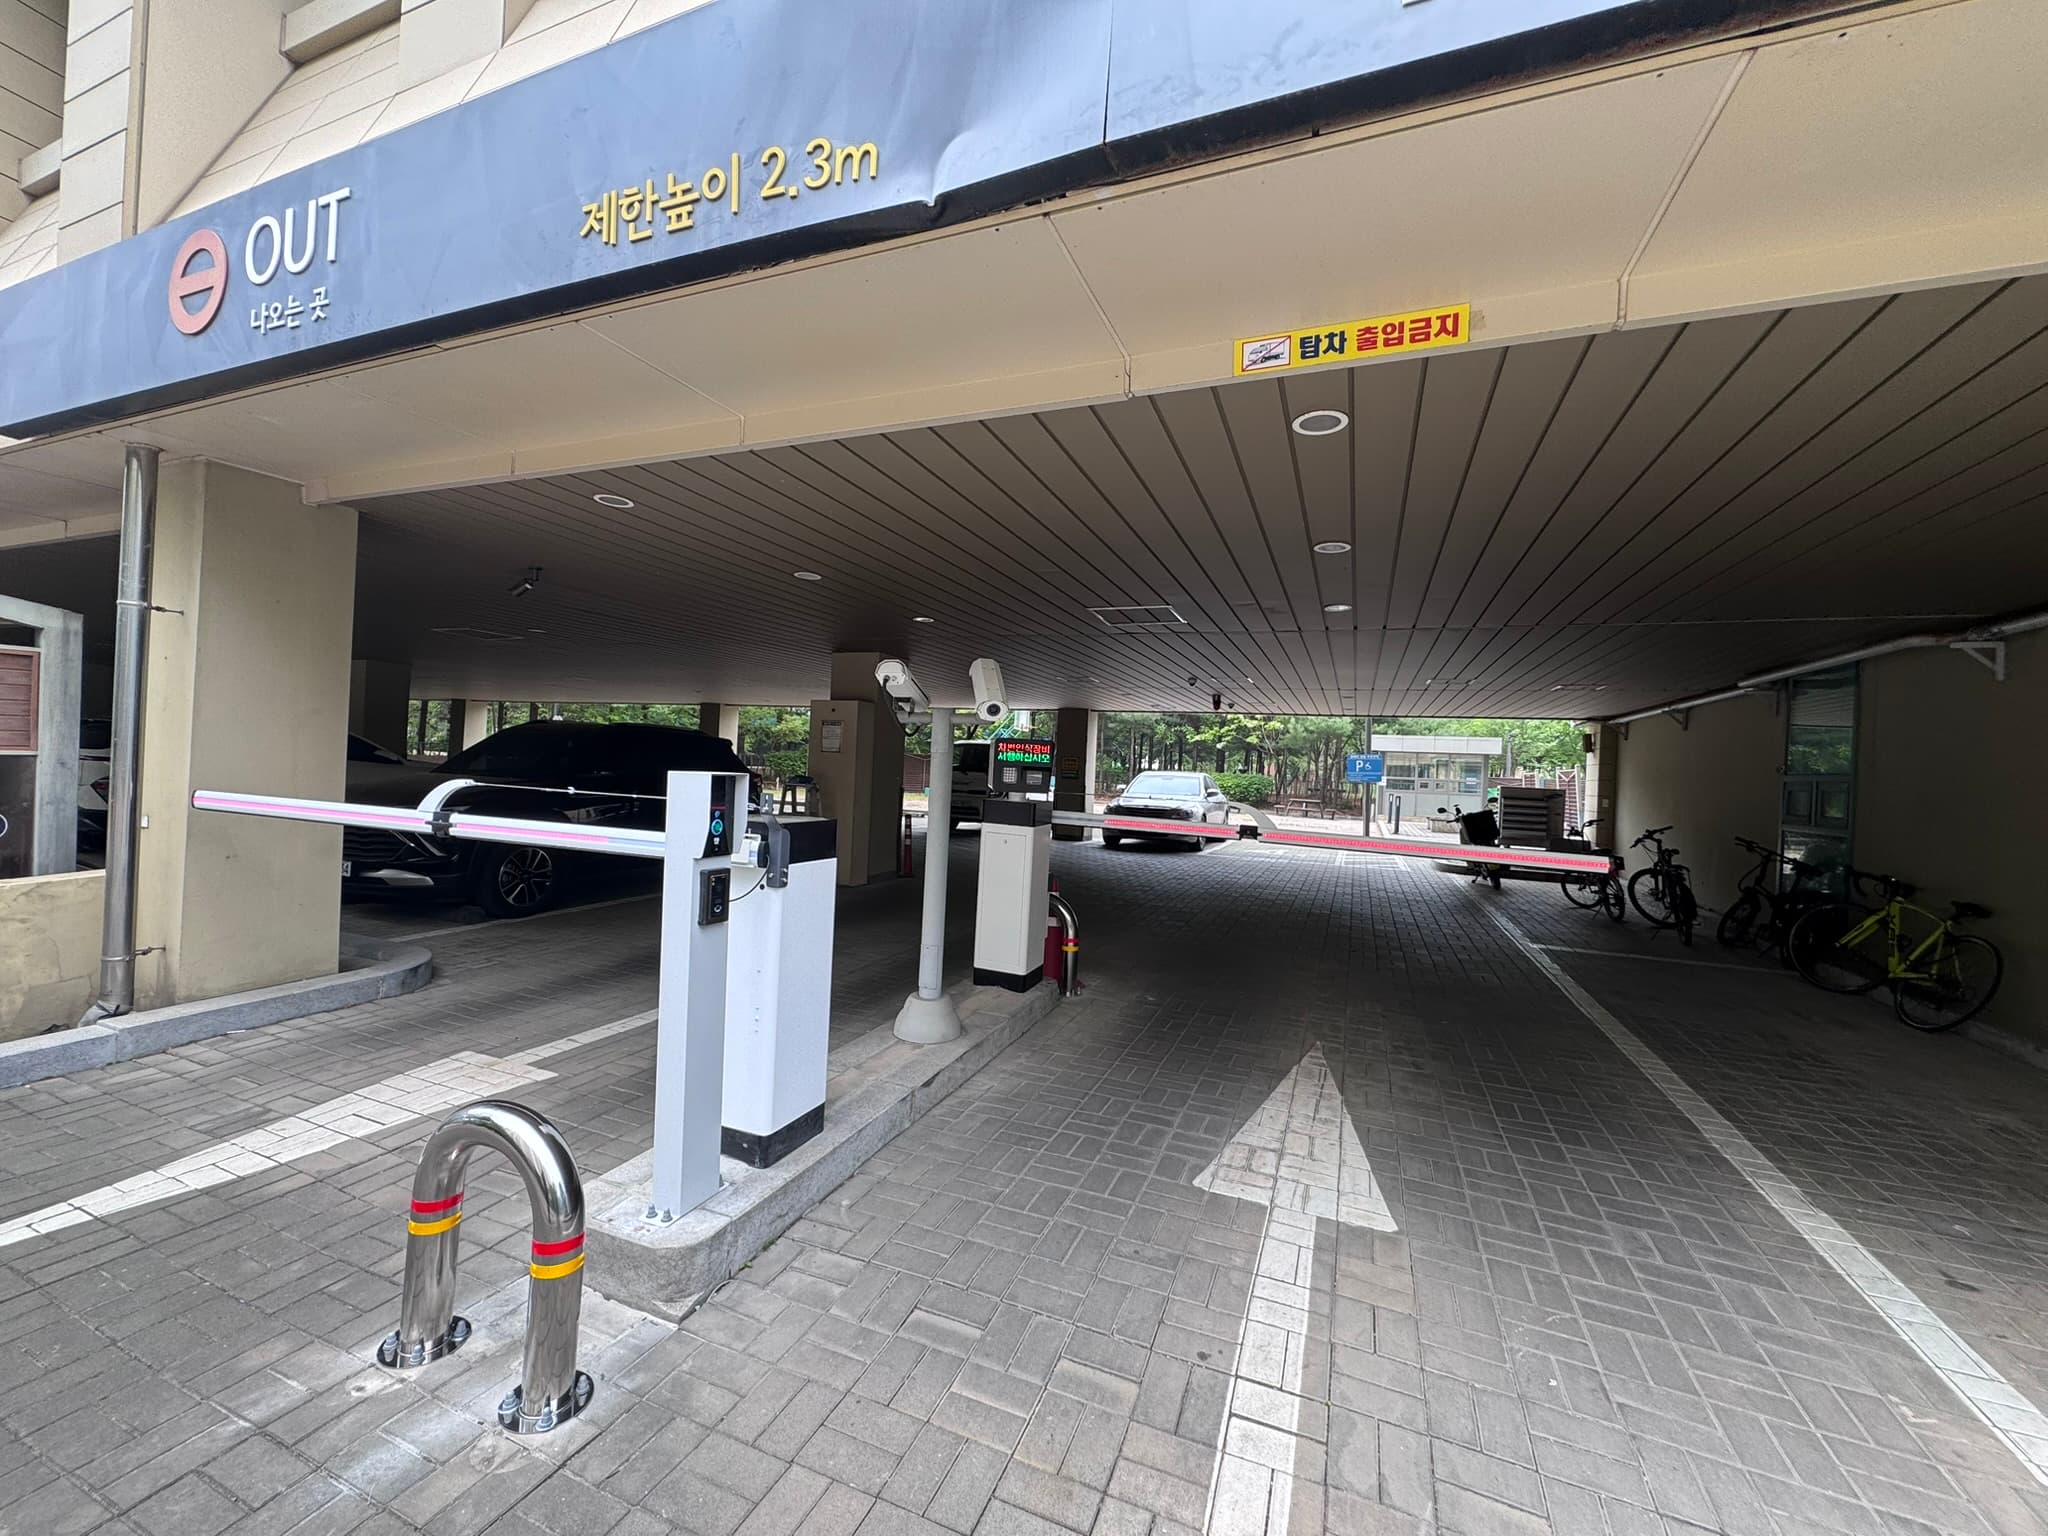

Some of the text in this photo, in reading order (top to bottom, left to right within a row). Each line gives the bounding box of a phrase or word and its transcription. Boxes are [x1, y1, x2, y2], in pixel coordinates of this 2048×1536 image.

[579, 137, 879, 246] 제한높이 2.3m
[245, 187, 351, 285] OUT
[250, 286, 330, 335] 나오는 곳
[1299, 312, 1460, 360] 탑차 출입금지
